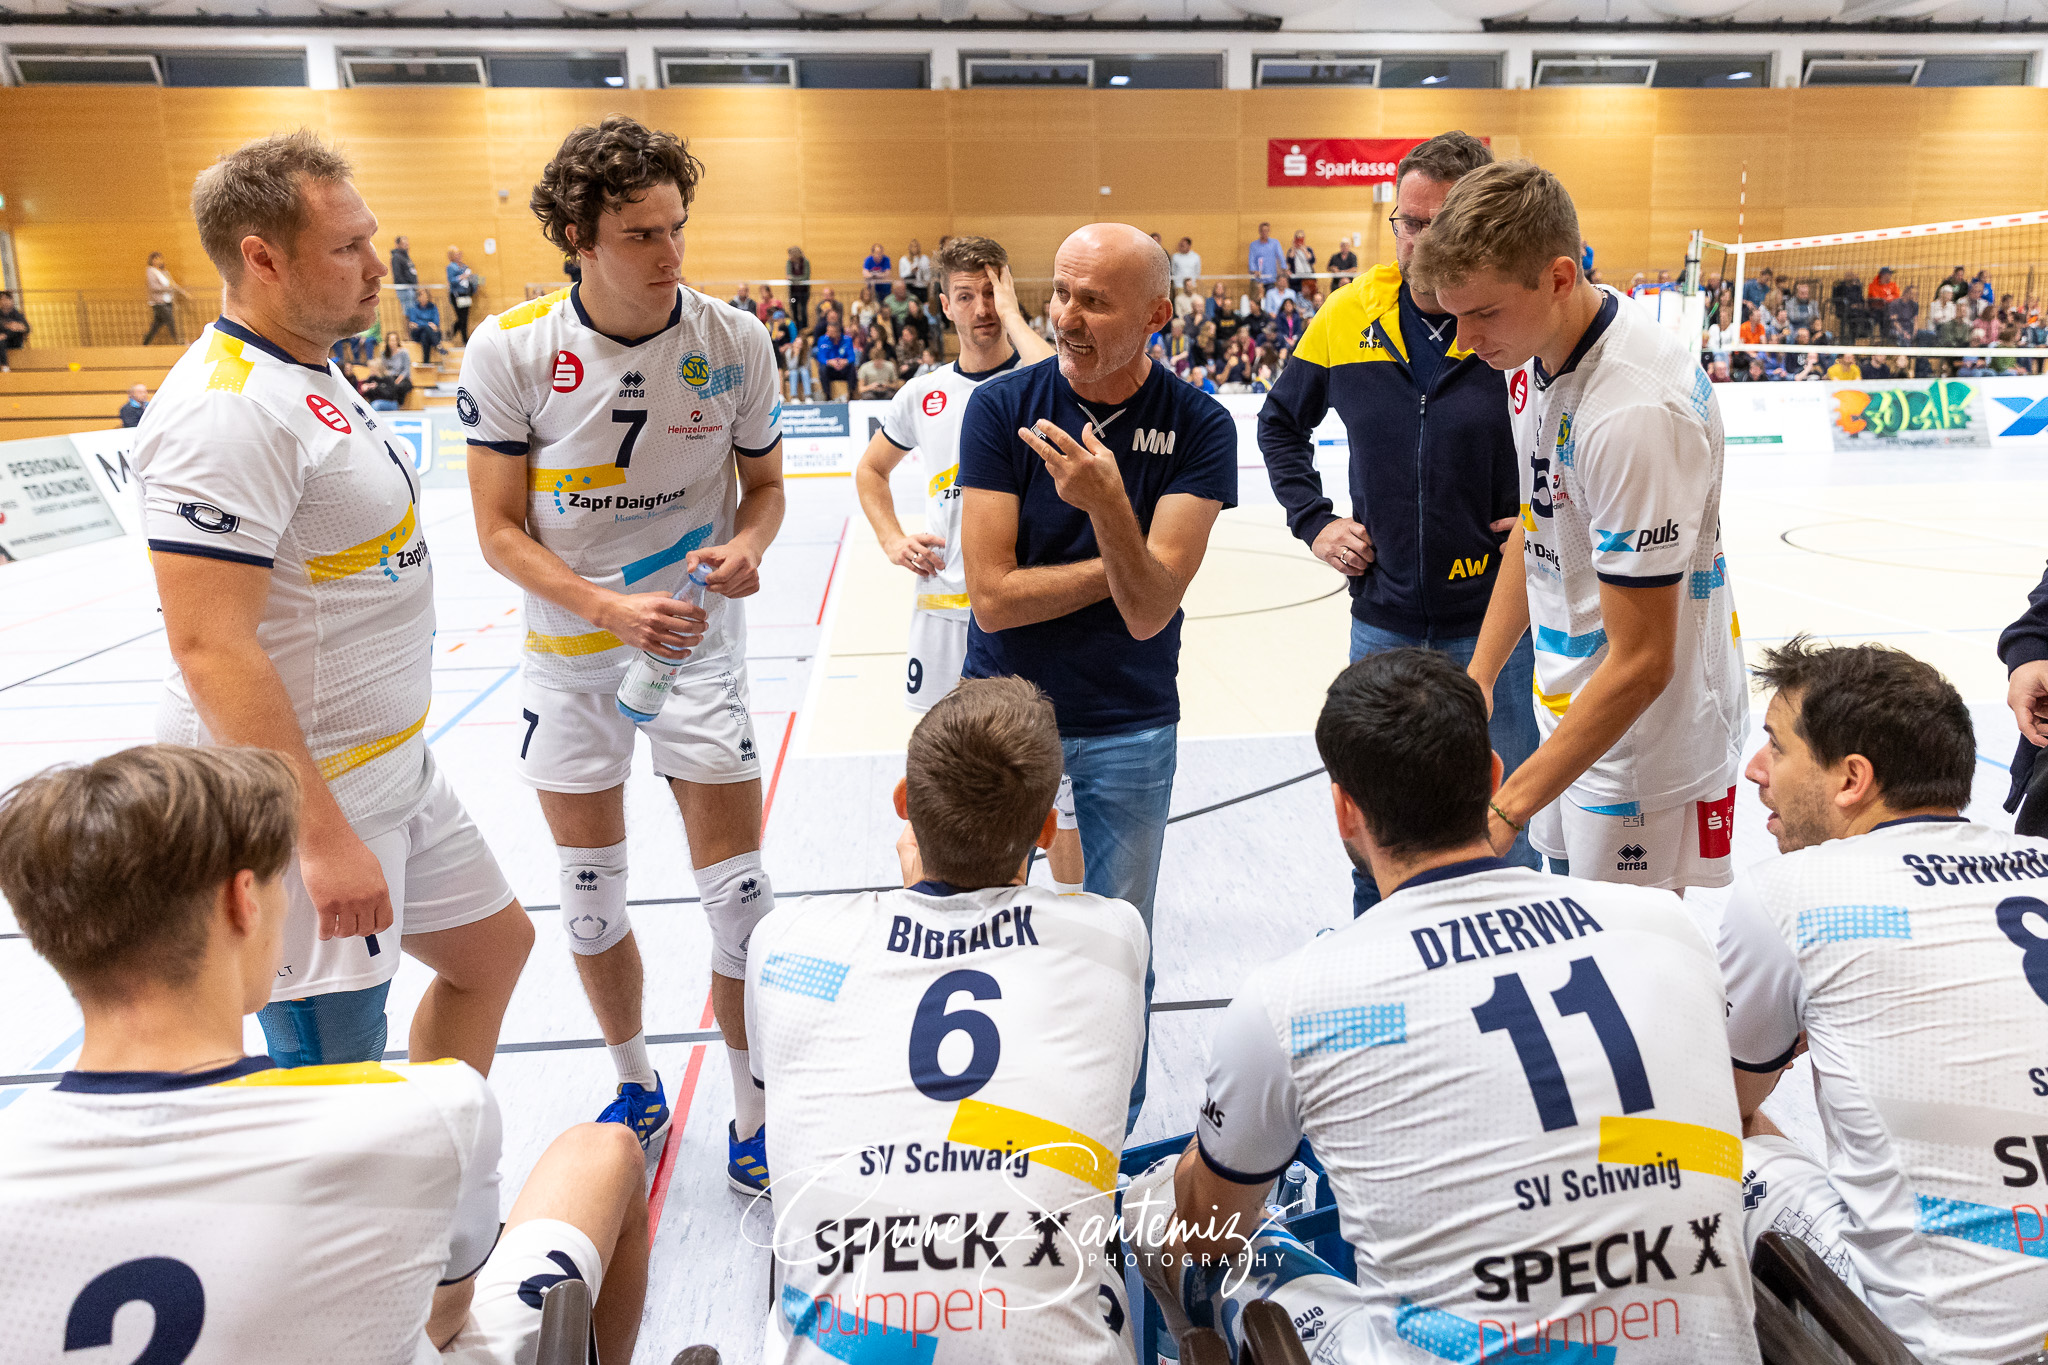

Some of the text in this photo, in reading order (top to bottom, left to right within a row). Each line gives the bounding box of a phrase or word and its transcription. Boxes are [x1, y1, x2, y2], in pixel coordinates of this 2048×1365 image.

[1314, 159, 1396, 179] Sparkasse
[618, 387, 645, 399] errea
[611, 409, 648, 469] 7
[667, 424, 723, 435] Heinzelmann
[1132, 427, 1177, 455] MM
[22, 477, 93, 501] TRAINING
[568, 487, 686, 513] Zapf Daigfuss
[1635, 518, 1680, 553] puls
[1447, 553, 1490, 581] AW
[906, 657, 923, 695] 9
[521, 707, 540, 760] 7
[740, 751, 757, 762] errea
[1617, 861, 1648, 871] errea
[575, 883, 598, 891] errea
[740, 889, 762, 904] errea
[887, 905, 1040, 960] BIBRACK
[1410, 896, 1604, 971] DZIERWA
[908, 968, 1003, 1102] 6
[1471, 955, 1656, 1133] 11
[859, 1140, 1030, 1178] SV Schwaig
[1514, 1151, 1682, 1211] SV Schwaig
[814, 1211, 1010, 1276] SPECK
[1472, 1224, 1678, 1303] SPECK
[813, 1286, 1007, 1349] pumpen
[1478, 1296, 1680, 1365] pumpen
